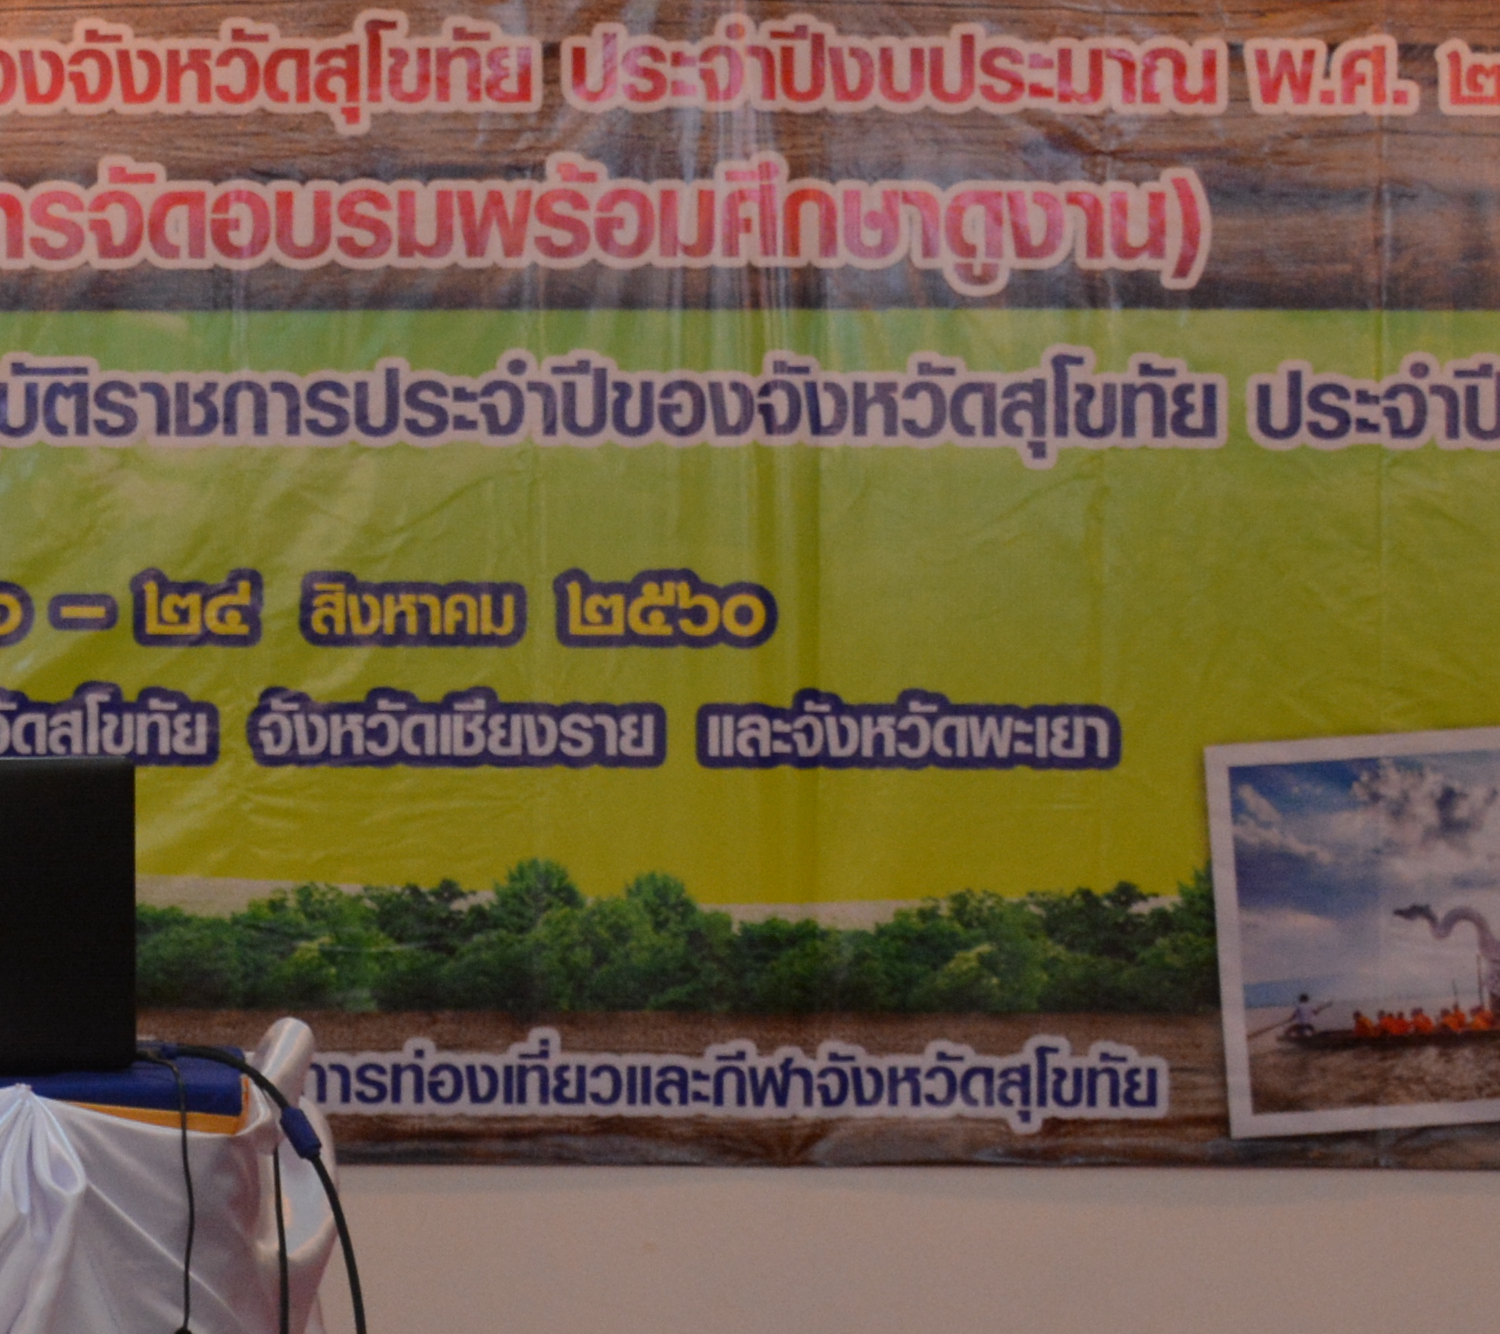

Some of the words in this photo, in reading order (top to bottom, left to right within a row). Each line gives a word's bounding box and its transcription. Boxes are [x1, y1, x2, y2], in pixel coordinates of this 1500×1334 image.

[571, 22, 1217, 106] ประจำปีงบประมาณ
[1254, 43, 1409, 106] พ.ศ.
[143, 580, 251, 636] ๒๔
[310, 581, 514, 636] สิงหาคม
[565, 580, 766, 637] ๒๕๖๐
[257, 696, 655, 758] จังหวัดเชียงราย
[707, 696, 1111, 759] และจังหวัดพะเยา
